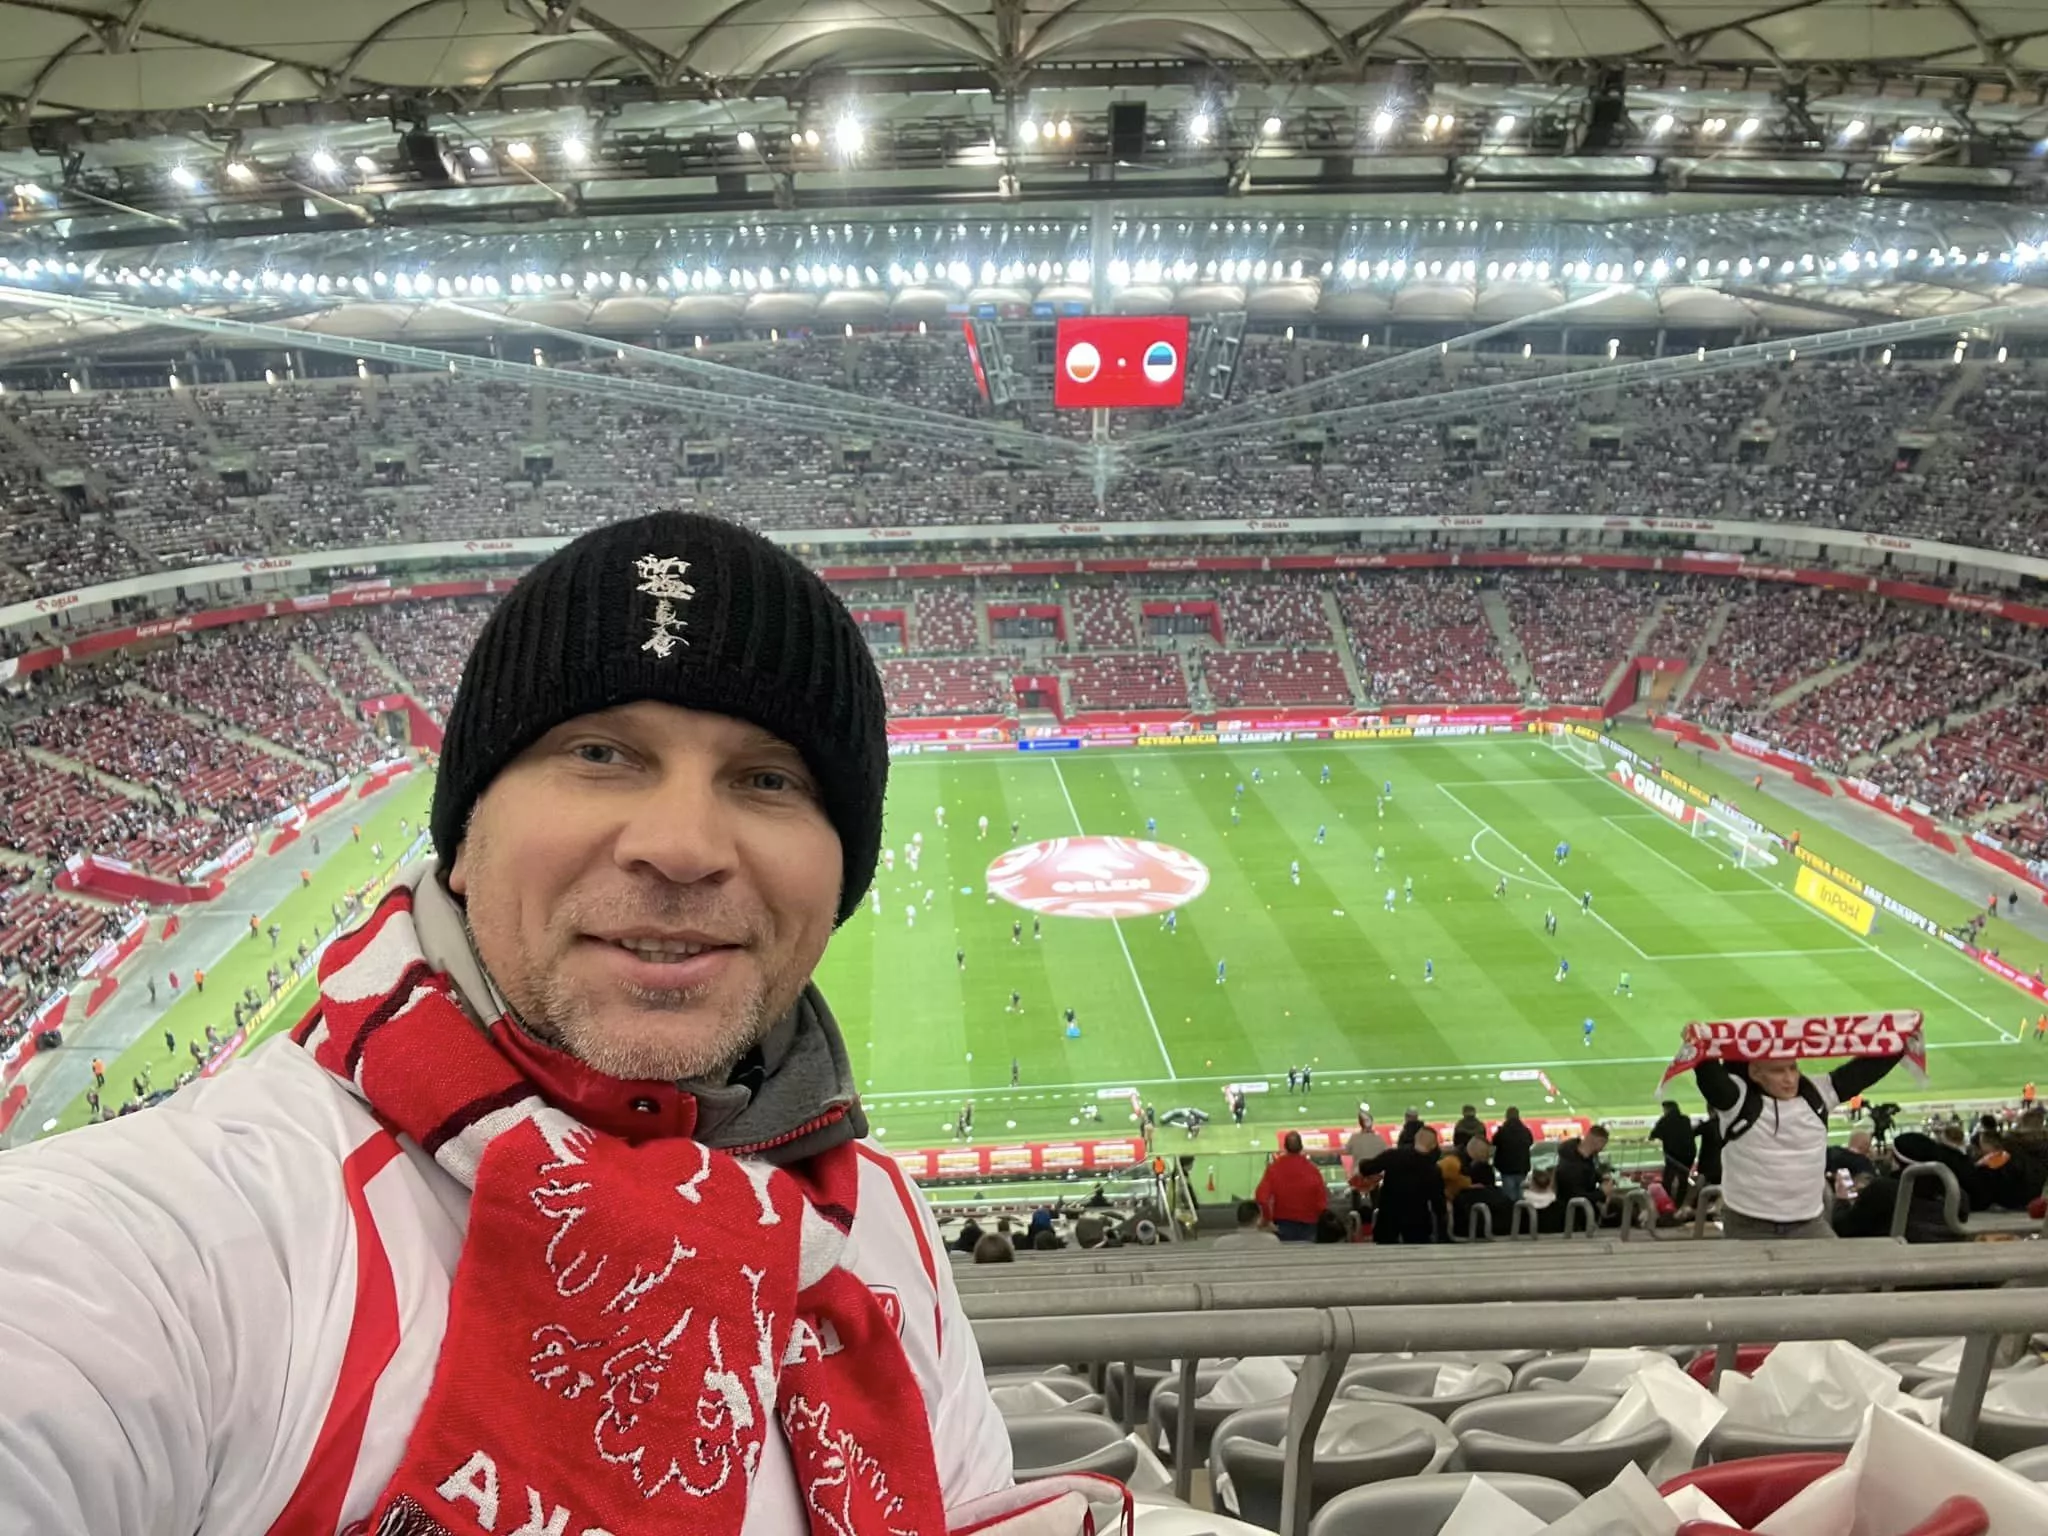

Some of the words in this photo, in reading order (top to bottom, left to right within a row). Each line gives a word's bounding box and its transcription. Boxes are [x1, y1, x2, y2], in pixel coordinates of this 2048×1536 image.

[259, 559, 292, 569] ORLEN
[1183, 734, 1217, 745] AKCJA
[1218, 733, 1239, 744] JAK
[1378, 727, 1412, 738] AKCJA
[1413, 726, 1434, 737] JAK
[1633, 773, 1686, 820] ORLEN
[1052, 878, 1151, 893] ORLEN
[1820, 885, 1860, 921] InPost
[1706, 1013, 1904, 1059] POLSKA
